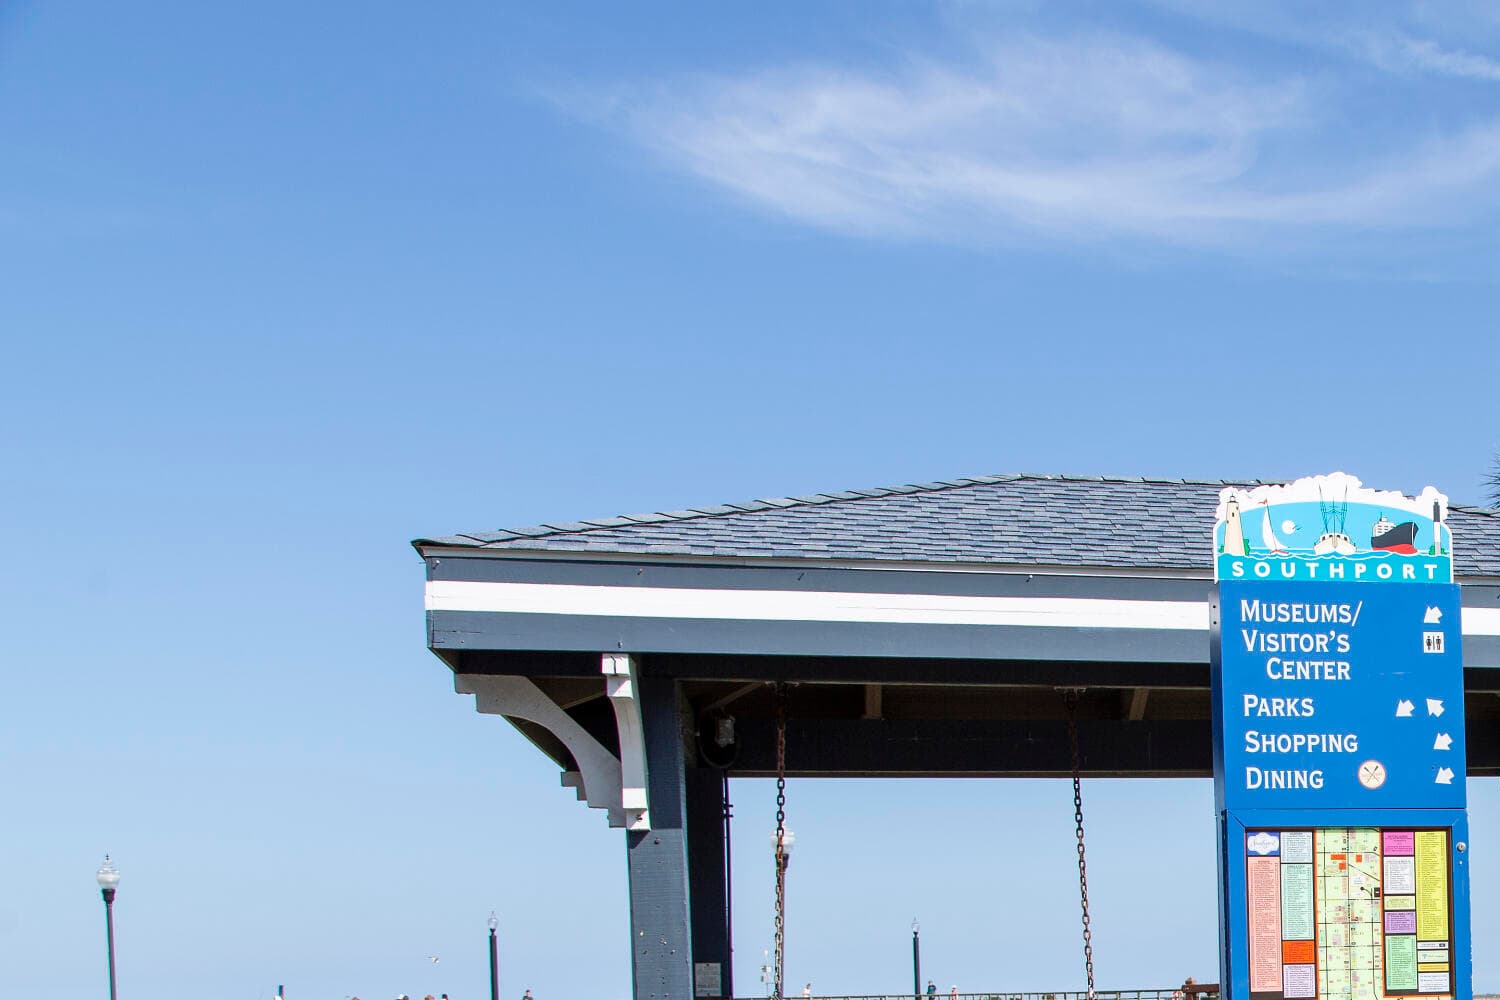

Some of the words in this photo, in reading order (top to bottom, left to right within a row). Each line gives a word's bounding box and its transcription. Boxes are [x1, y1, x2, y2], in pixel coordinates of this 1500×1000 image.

[1231, 560, 1438, 579] SOUTHPORT
[1240, 599, 1363, 627] MUSEUMS/
[1266, 656, 1351, 681] CENTER
[1243, 694, 1315, 717] PARKS
[1244, 730, 1359, 753] SHOPPING
[1245, 766, 1324, 790] DINING
